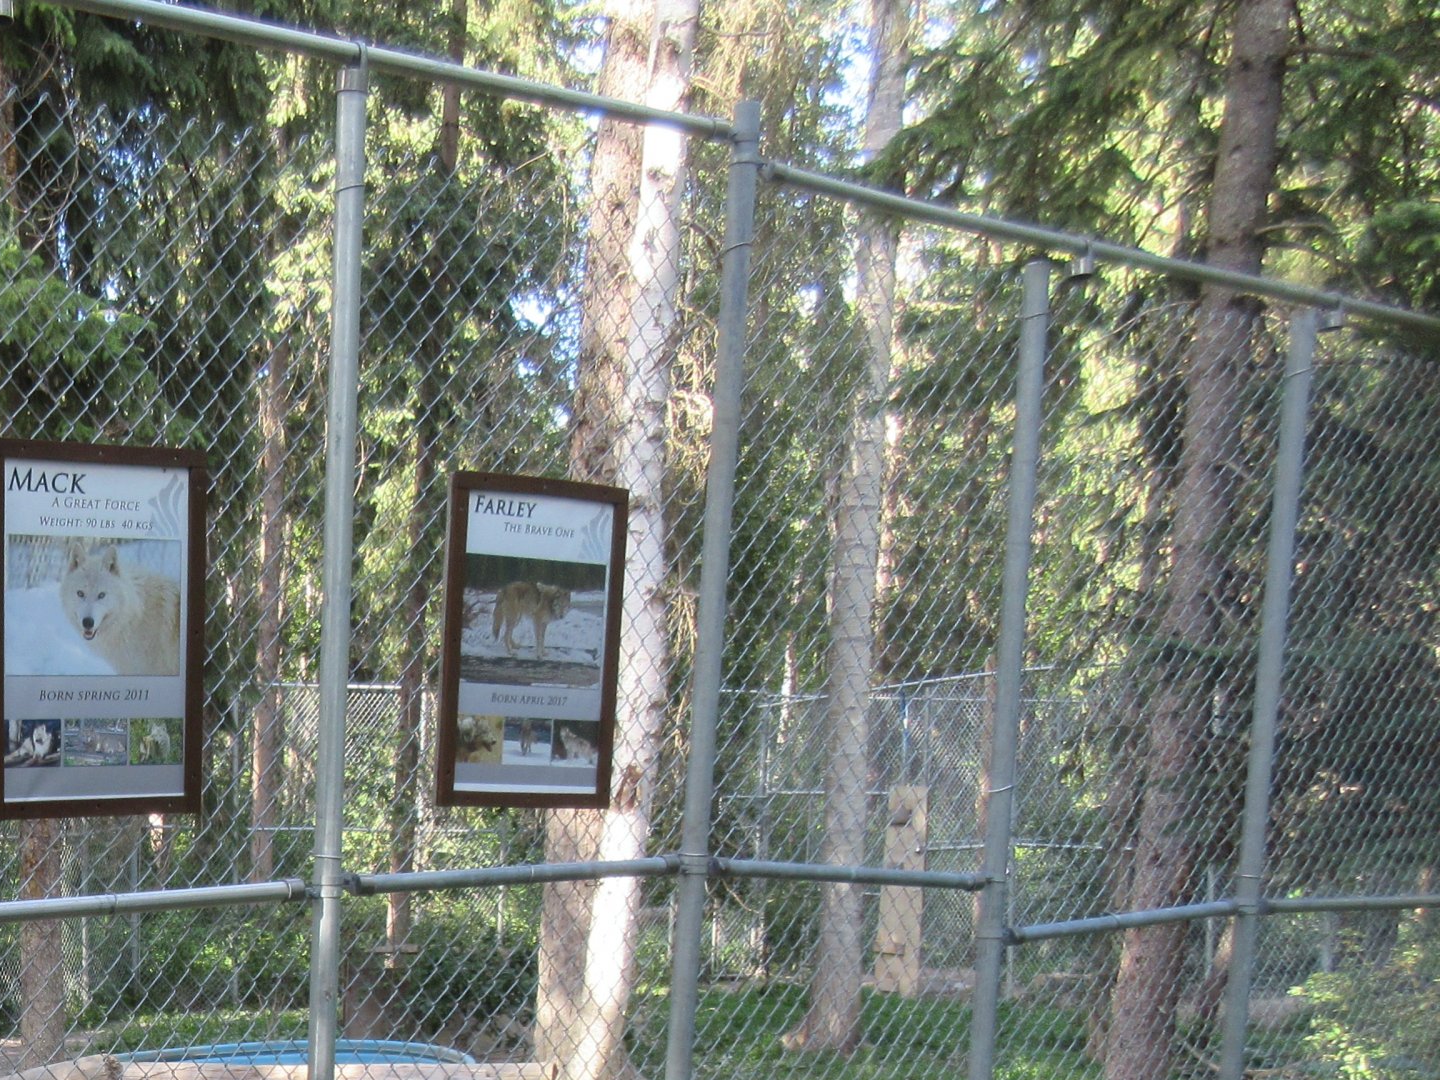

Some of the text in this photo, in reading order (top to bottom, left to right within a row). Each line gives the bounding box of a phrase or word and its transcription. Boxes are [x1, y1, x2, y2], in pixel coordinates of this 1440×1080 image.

[8, 466, 86, 495] MACK
[51, 497, 141, 512] A GREAT FORCE
[474, 495, 537, 519] FARLEY
[39, 516, 153, 531] WEIGHT: 90 LBS 40 KGS
[504, 521, 575, 538] THE BRAVE ONE
[39, 689, 150, 701] BORN SPRING 2011
[491, 692, 568, 706] BORN APRIL 2017
